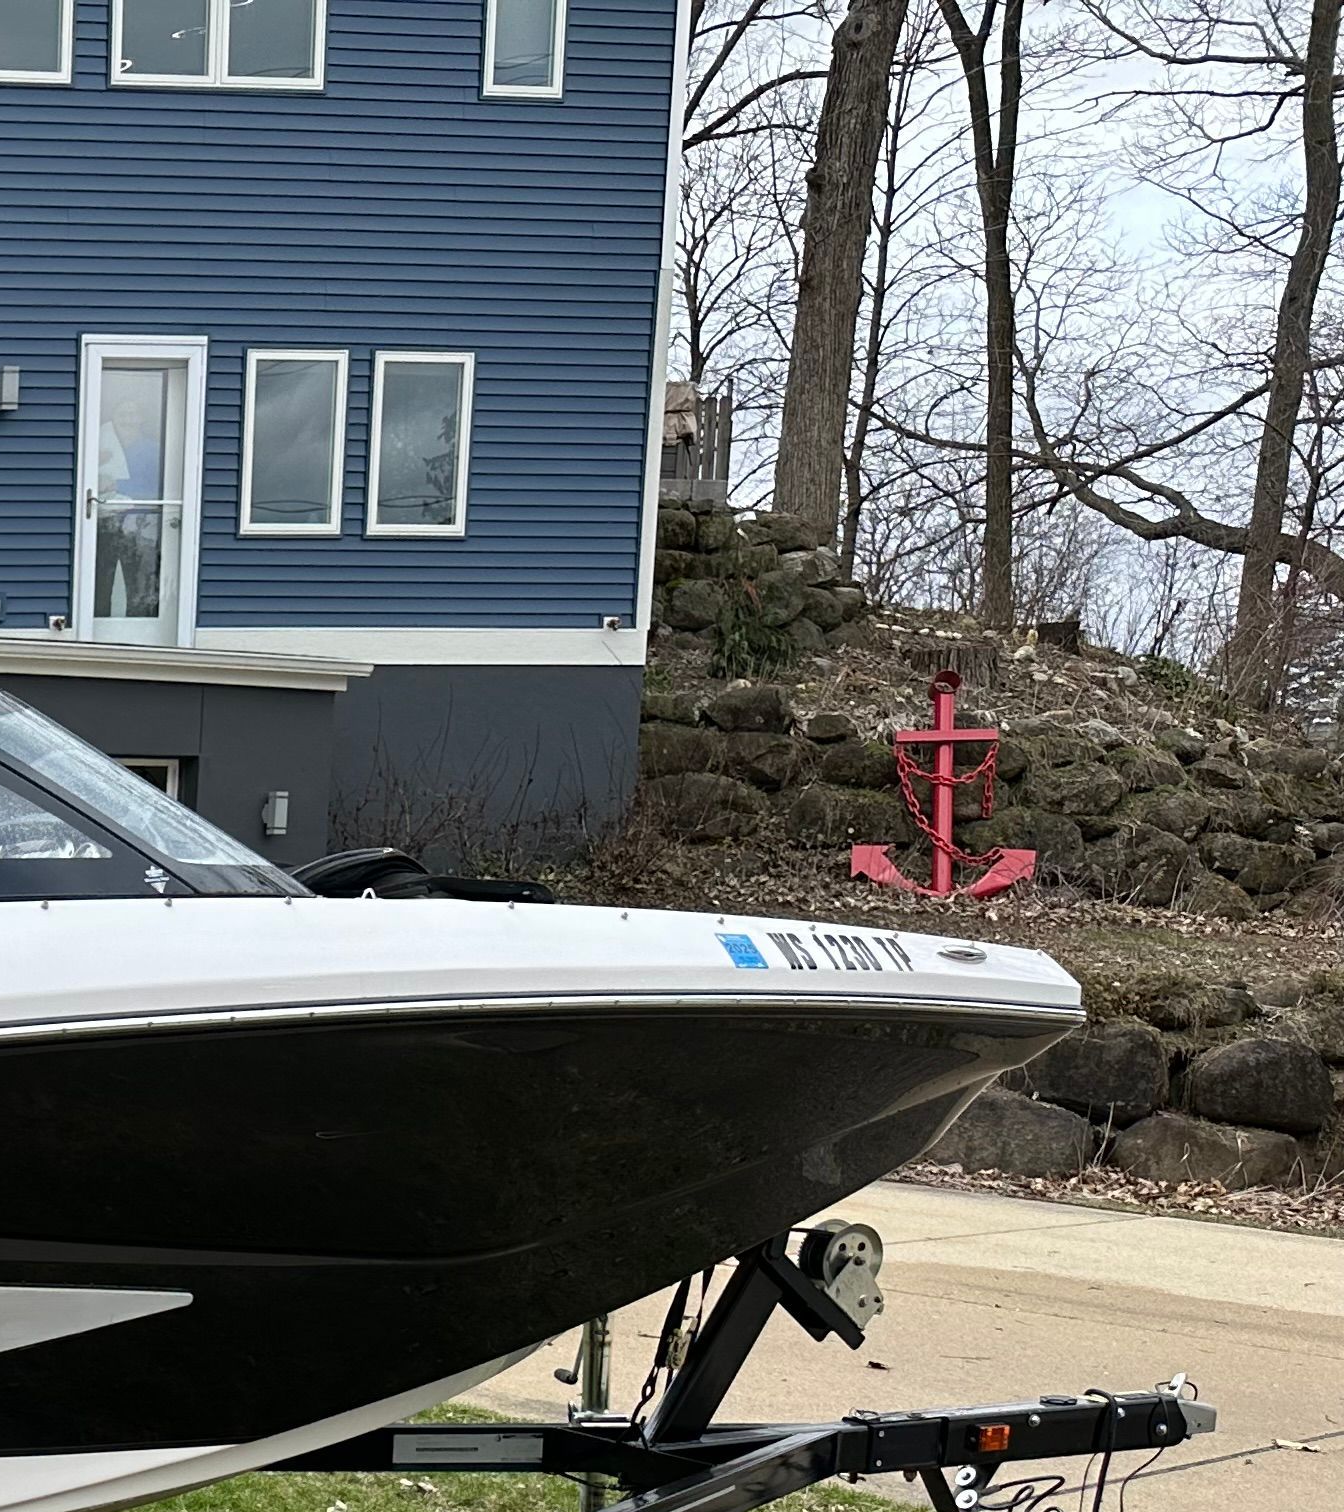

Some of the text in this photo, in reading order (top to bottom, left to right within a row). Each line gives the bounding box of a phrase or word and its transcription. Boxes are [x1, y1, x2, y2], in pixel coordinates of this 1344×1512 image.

[765, 932, 914, 972] WS 1230 TP
